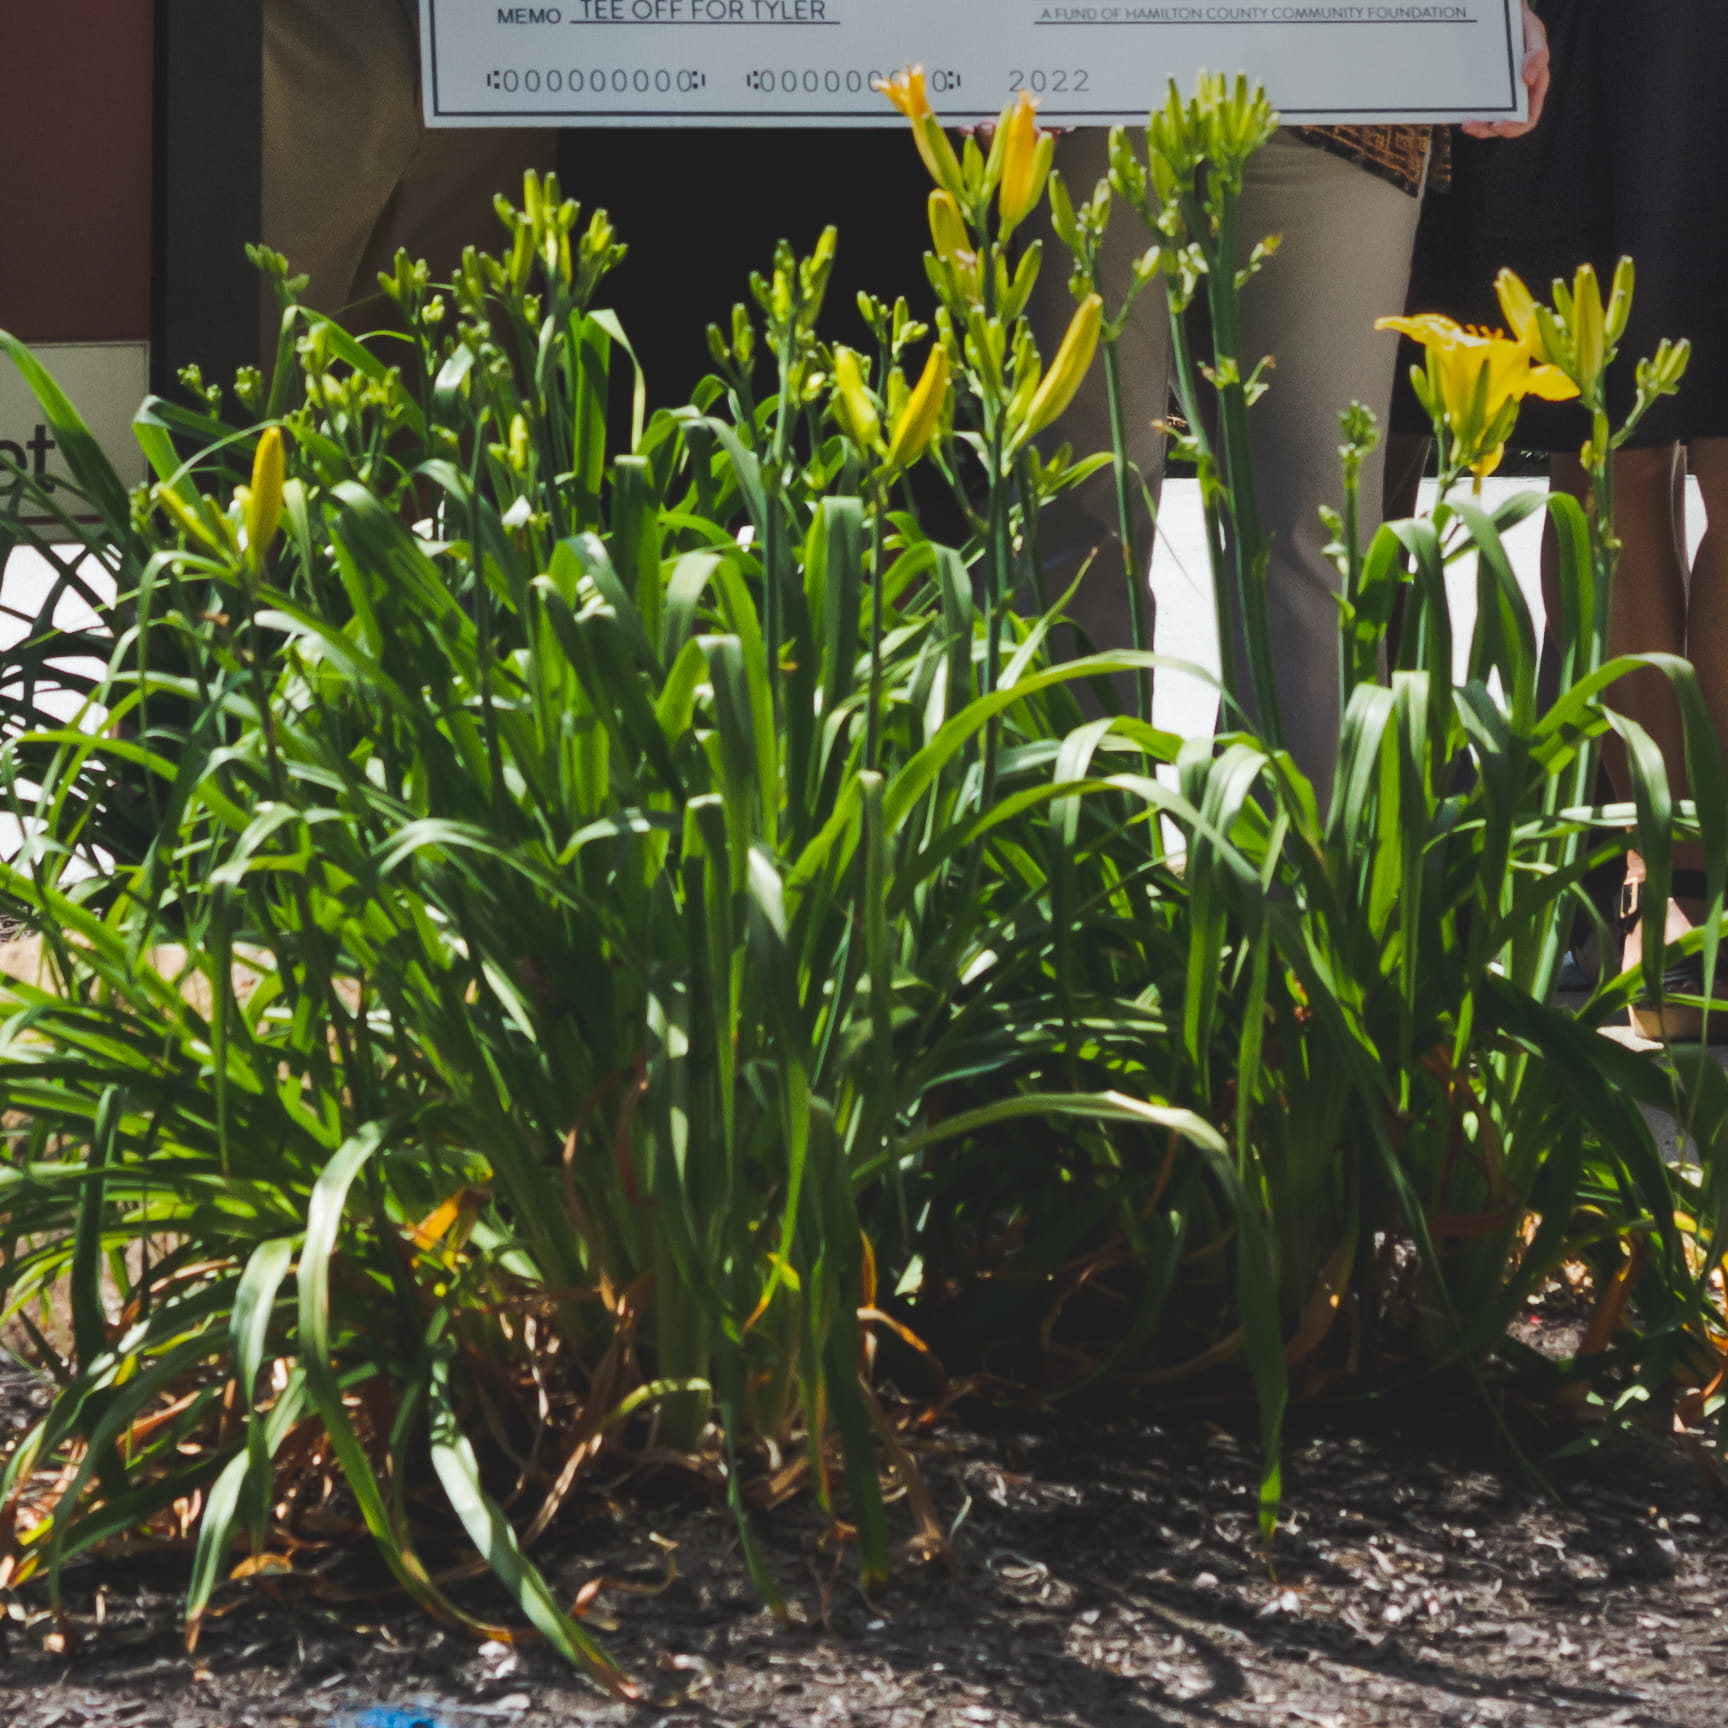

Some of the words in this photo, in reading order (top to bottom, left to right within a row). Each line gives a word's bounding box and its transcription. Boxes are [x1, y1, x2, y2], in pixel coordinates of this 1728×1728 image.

[497, 8, 562, 25] MEMO
[579, 0, 624, 20] TEE
[632, 0, 683, 20] OFF
[691, 0, 744, 20] FOR
[750, 0, 826, 20] TYLER
[1041, 8, 1052, 21] A
[1055, 7, 1097, 21] FUND
[1102, 7, 1121, 21] OF
[1126, 7, 1201, 20] HAMILTON
[1206, 6, 1268, 20] COUNTY
[1272, 5, 1364, 20] COMMUNITY
[1368, 5, 1467, 19] FOUNDATION
[1009, 69, 1090, 93] 2022
